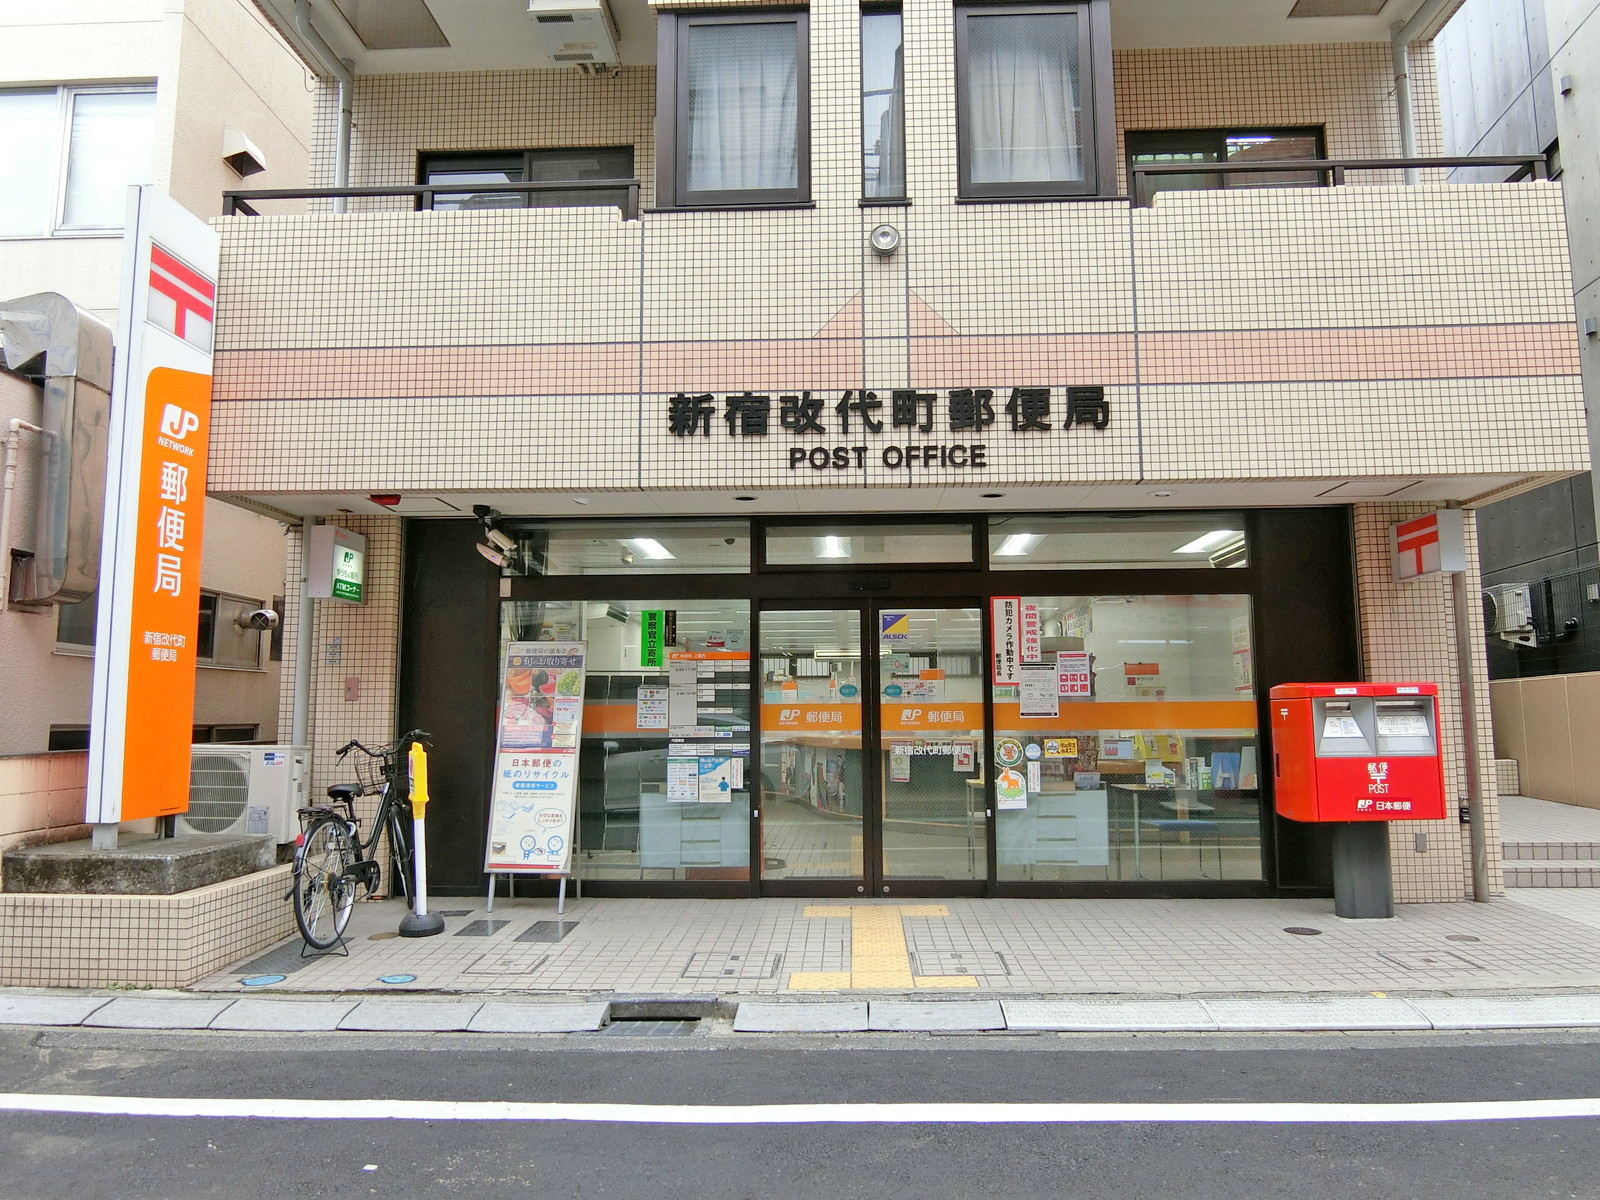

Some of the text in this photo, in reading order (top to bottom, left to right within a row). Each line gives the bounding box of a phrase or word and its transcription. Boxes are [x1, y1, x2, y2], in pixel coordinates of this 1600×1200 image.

[668, 387, 1110, 436] 新宿改代町郵便局
[157, 436, 194, 457] NETWORK
[790, 444, 987, 469] POST OFFICE
[153, 461, 188, 597] 郵便局
[143, 631, 186, 648] 新宿改代町
[647, 612, 657, 667] 警察官立寄所
[1025, 605, 1038, 660] 夜間警戒強化中
[1005, 601, 1014, 680] 防犯カメラ作動中です
[151, 647, 177, 662] 郵便局
[523, 656, 577, 666] 旬のお取り寄せ
[806, 711, 842, 723] 郵便局
[927, 710, 965, 723] 郵便局
[894, 746, 971, 756] 新宿改代町郵便局
[512, 758, 562, 768] 日本郵便の
[1367, 762, 1388, 774] 郵便
[503, 769, 569, 779] 紙のリサイクル
[1368, 784, 1389, 793] POST
[1376, 801, 1412, 811] 日本郵便
